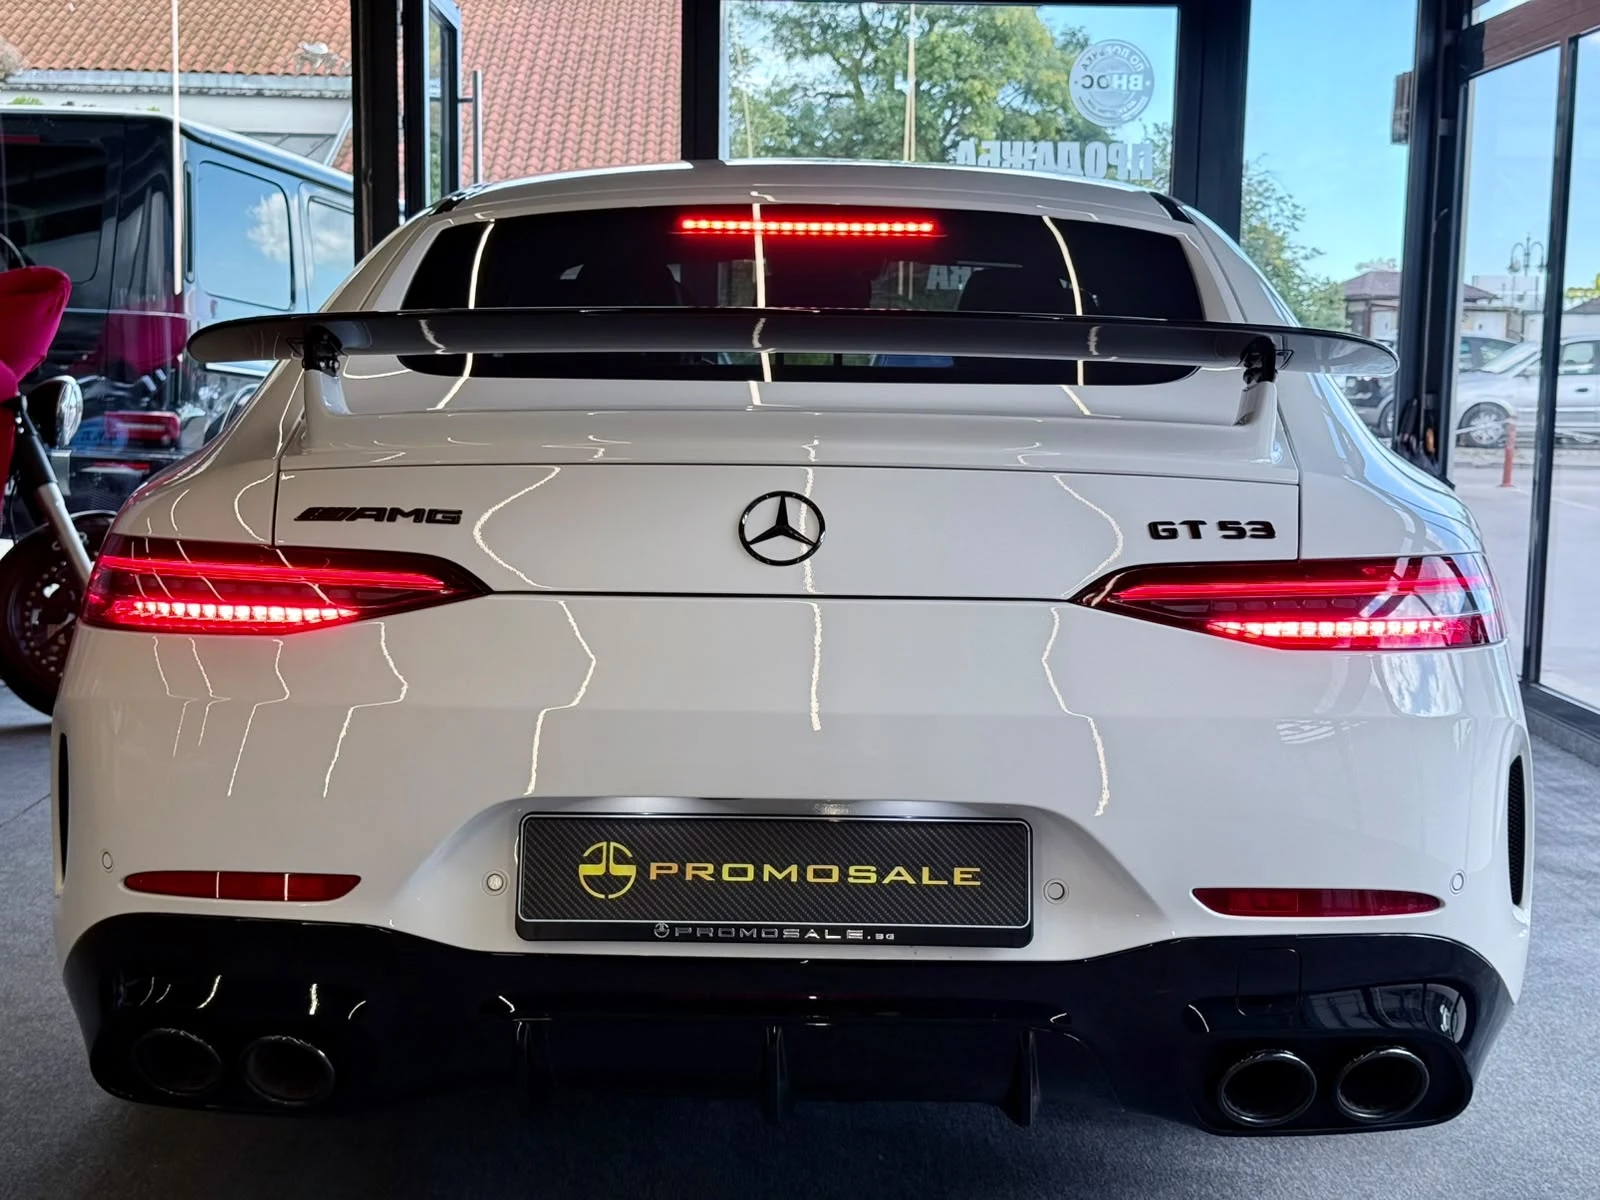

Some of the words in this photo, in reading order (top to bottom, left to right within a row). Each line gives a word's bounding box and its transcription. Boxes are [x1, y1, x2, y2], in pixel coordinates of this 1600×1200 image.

[345, 506, 463, 525] AMG
[1147, 520, 1207, 540] GT
[1217, 520, 1276, 540] 53
[649, 862, 981, 886] PROMOSALE
